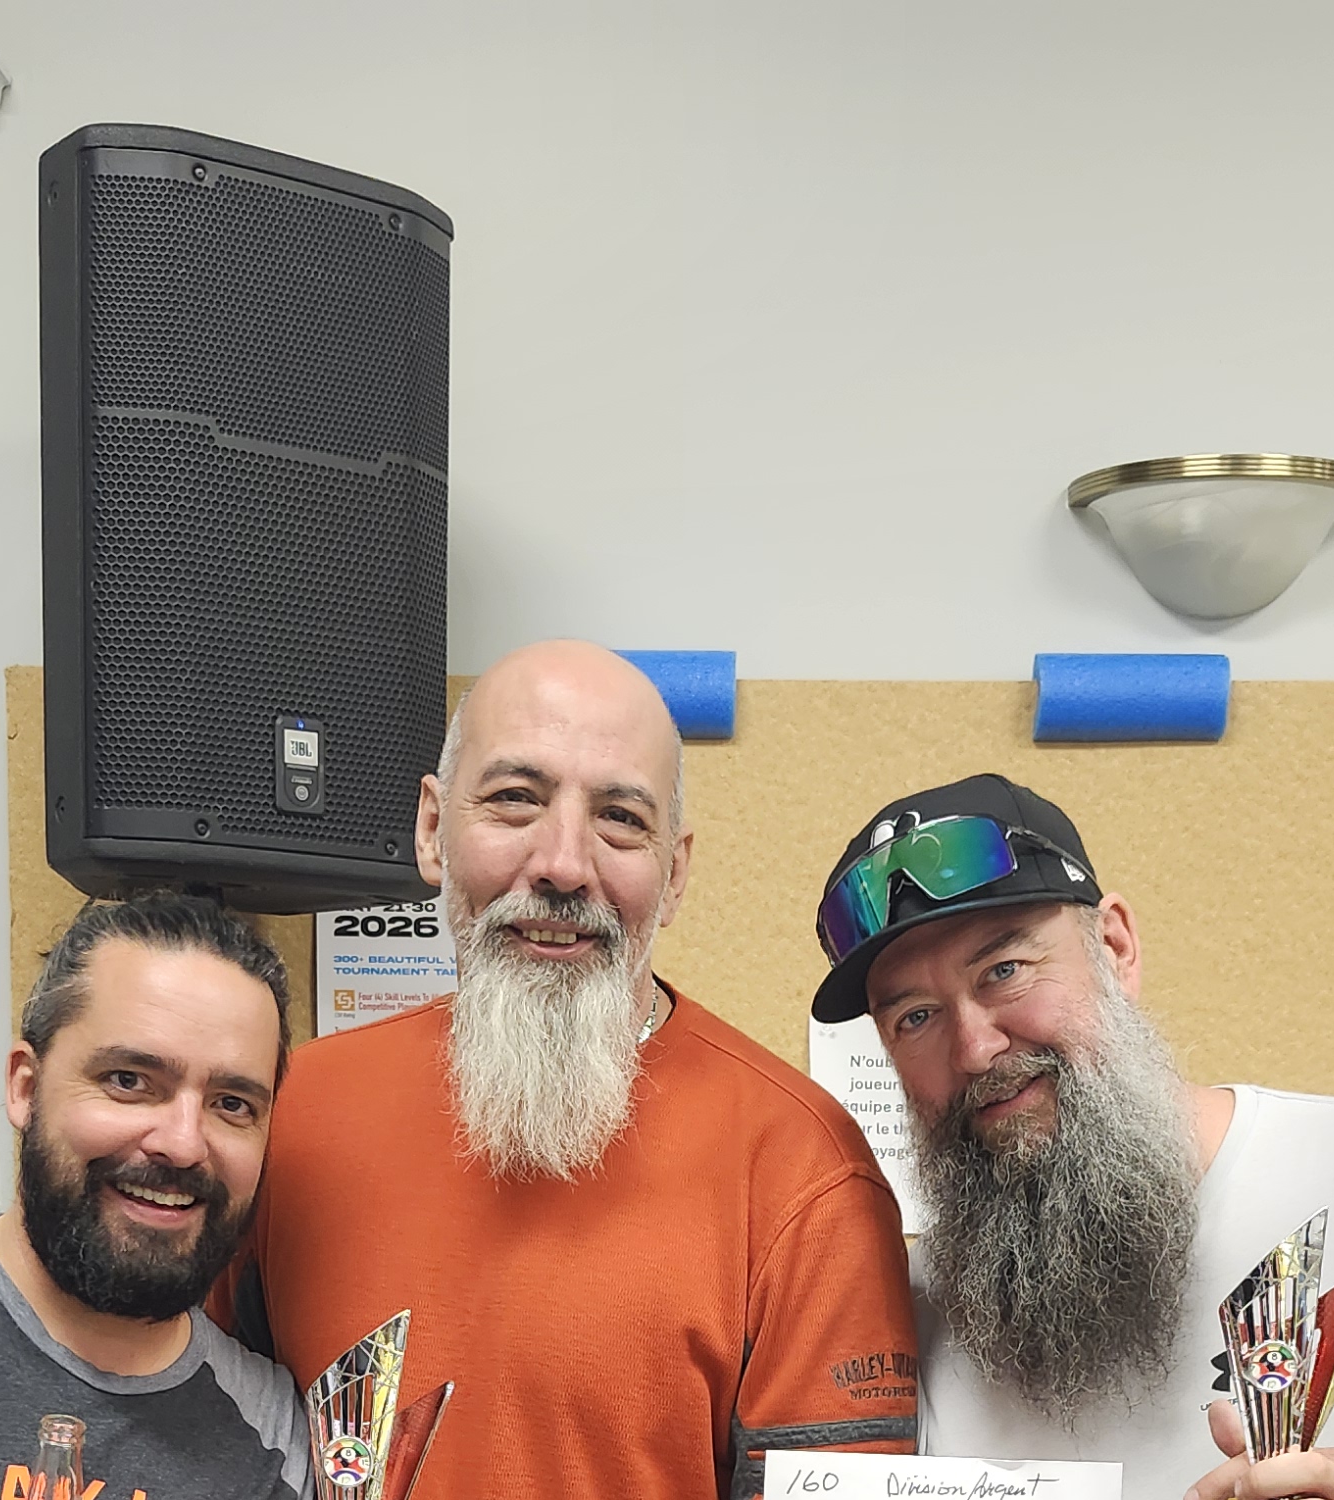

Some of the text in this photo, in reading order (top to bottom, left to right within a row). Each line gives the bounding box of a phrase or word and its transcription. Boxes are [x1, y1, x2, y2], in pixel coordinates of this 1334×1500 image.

[291, 741, 312, 757] JBL
[334, 915, 439, 938] 2026
[368, 956, 444, 964] BEAUTIFUL
[333, 967, 429, 976] TOURNAMENT
[358, 992, 372, 1001] Four
[385, 992, 399, 1001] Skill
[400, 992, 421, 1001] Levels
[358, 1002, 396, 1012] Competitive
[786, 1470, 839, 1495] 160
[887, 1472, 967, 1498] Division
